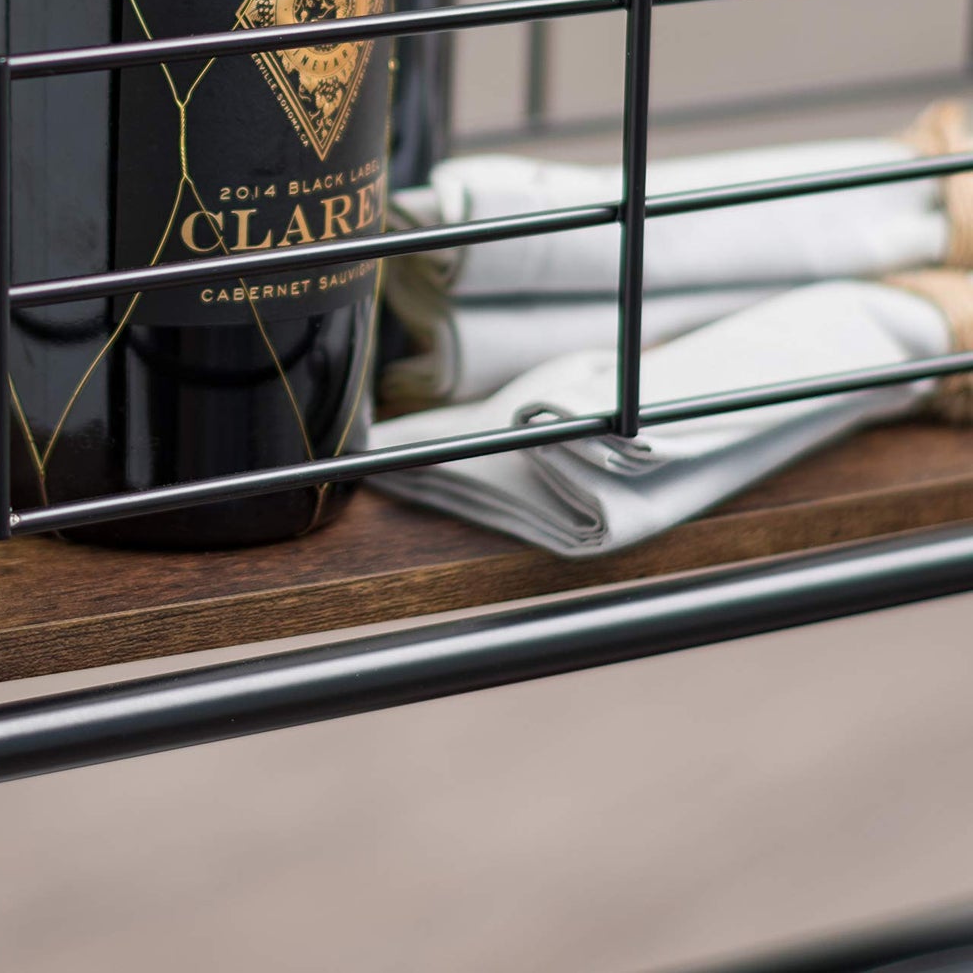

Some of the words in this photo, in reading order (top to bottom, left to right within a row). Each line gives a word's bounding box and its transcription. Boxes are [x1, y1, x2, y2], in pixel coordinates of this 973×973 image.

[292, 48, 348, 71] INEYAR
[219, 185, 276, 201] 2014
[288, 172, 344, 195] BLACK
[200, 279, 310, 303] CABERNET
